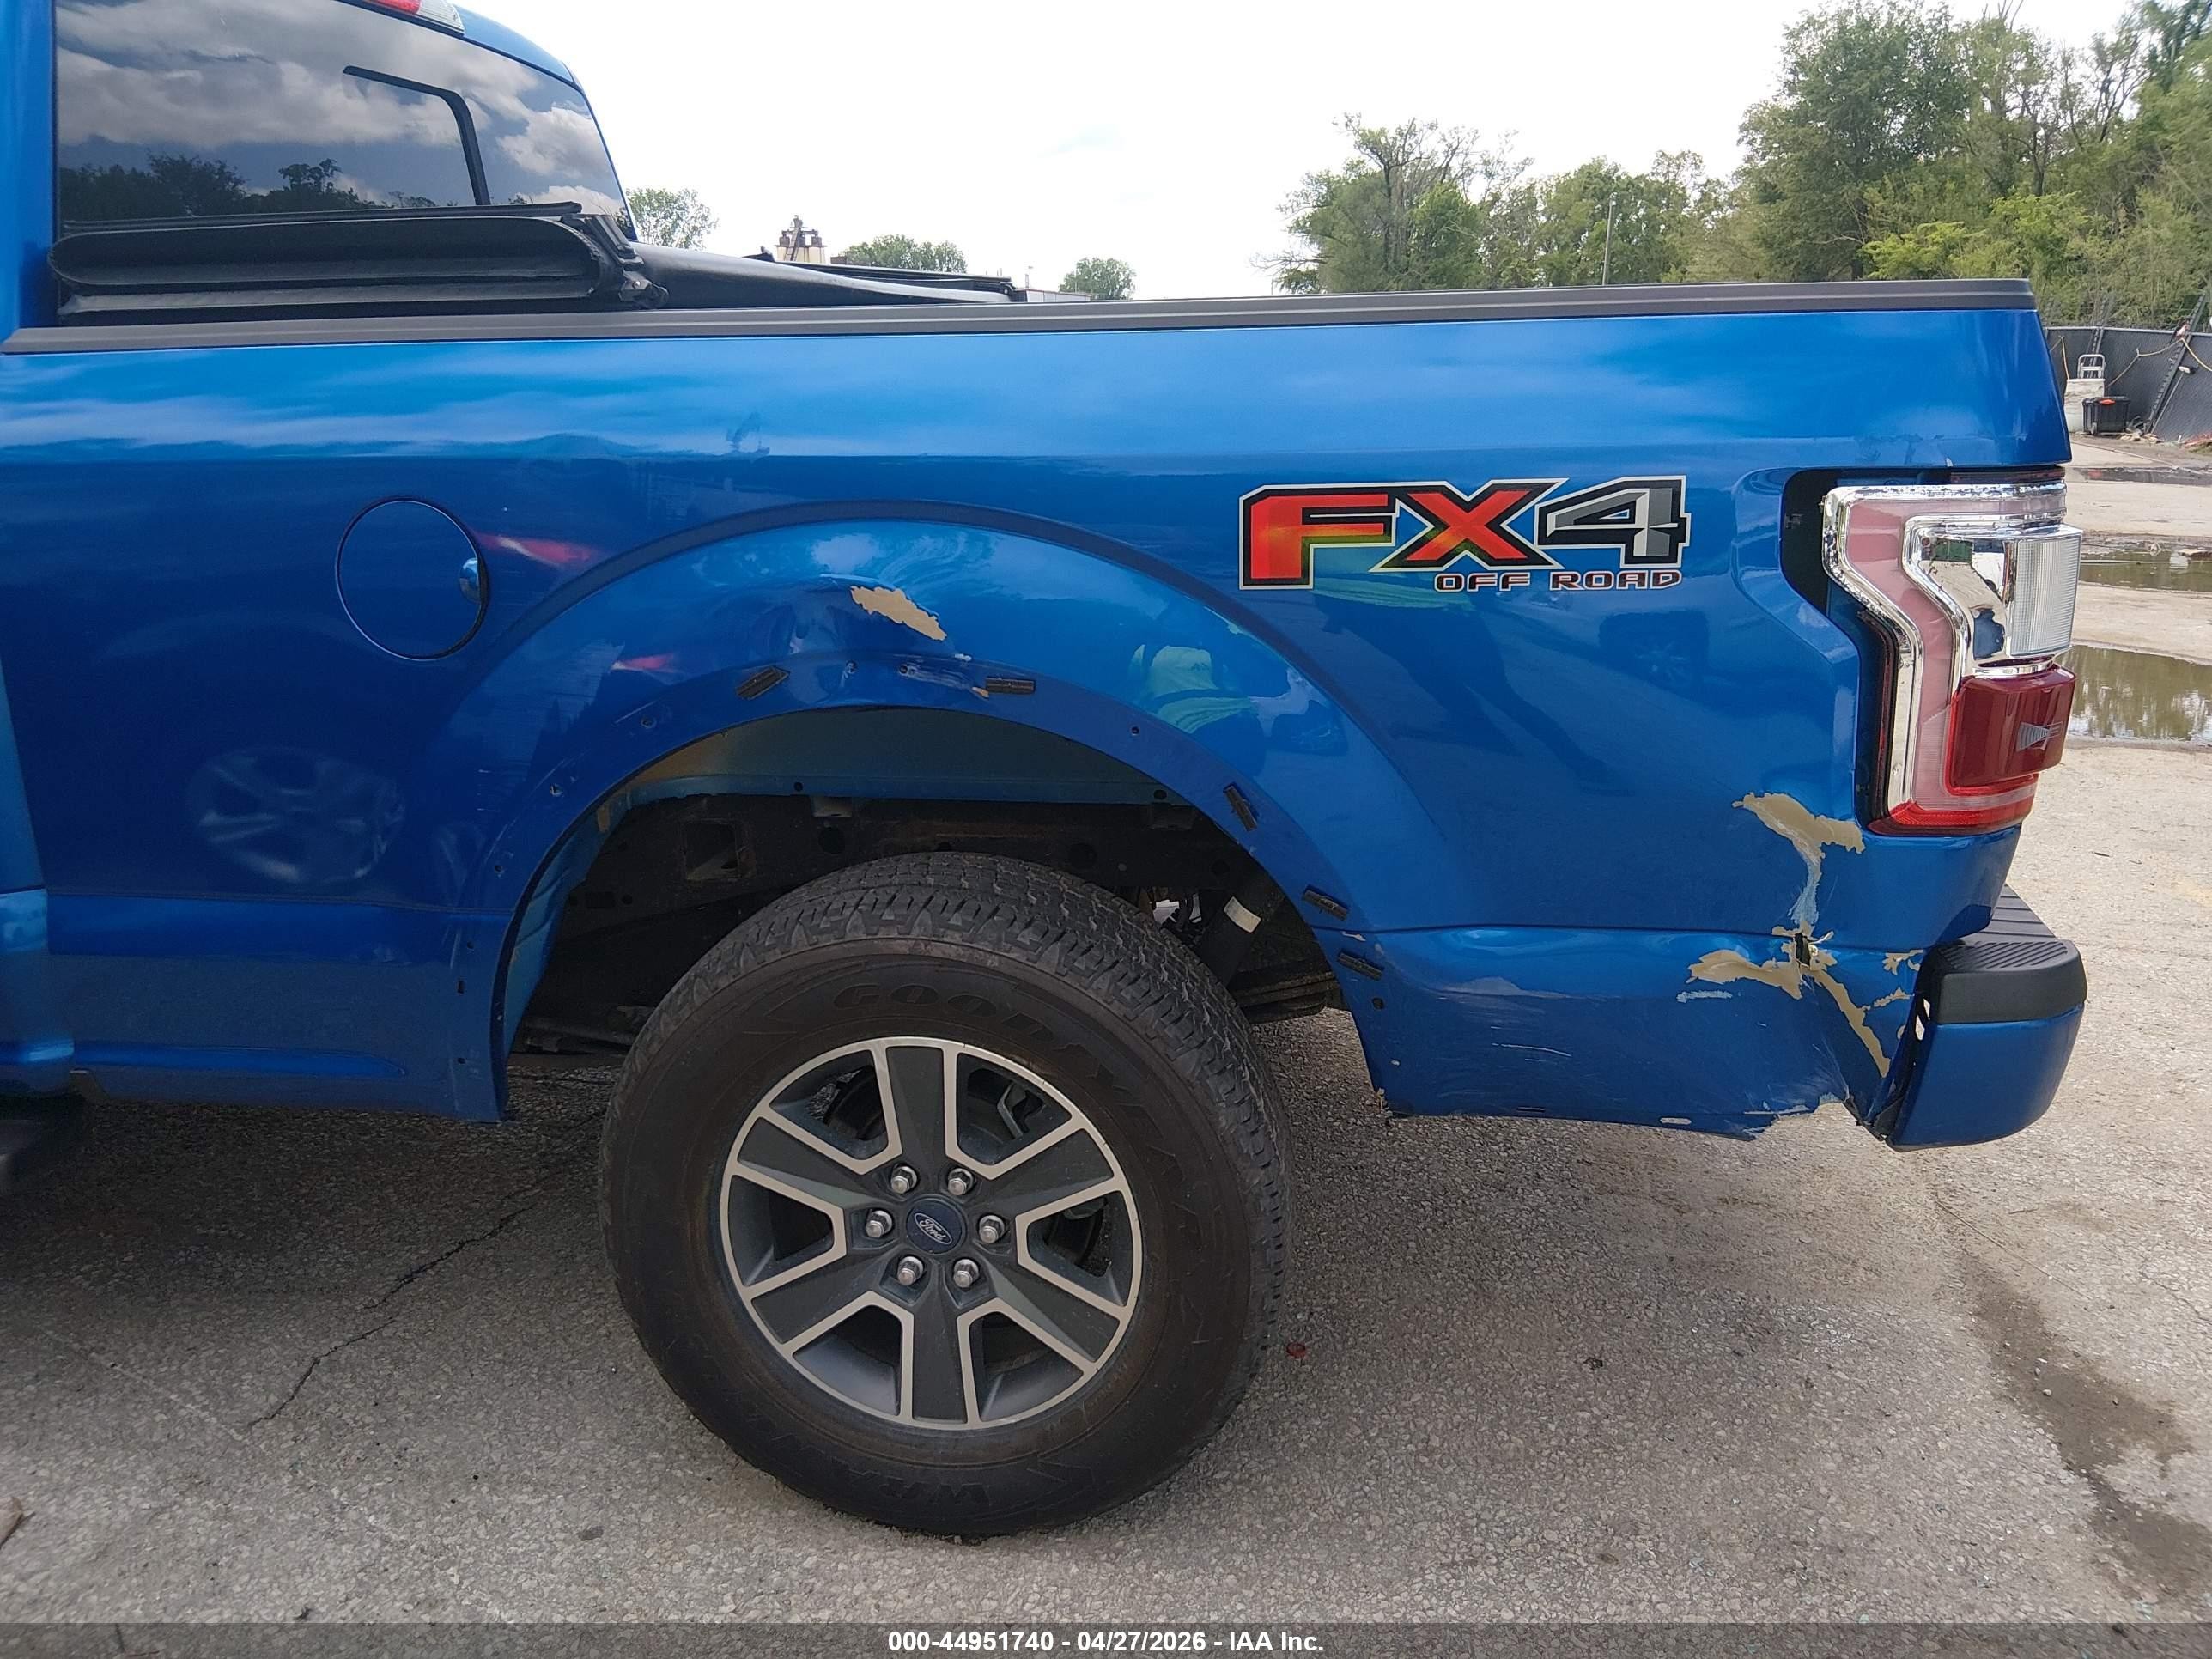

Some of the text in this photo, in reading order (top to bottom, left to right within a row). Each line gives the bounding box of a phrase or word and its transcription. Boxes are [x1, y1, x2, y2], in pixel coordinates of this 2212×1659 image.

[1239, 475, 1691, 590] FX4
[1434, 570, 1682, 592] OFF ROAD
[918, 1218, 947, 1241] Ford
